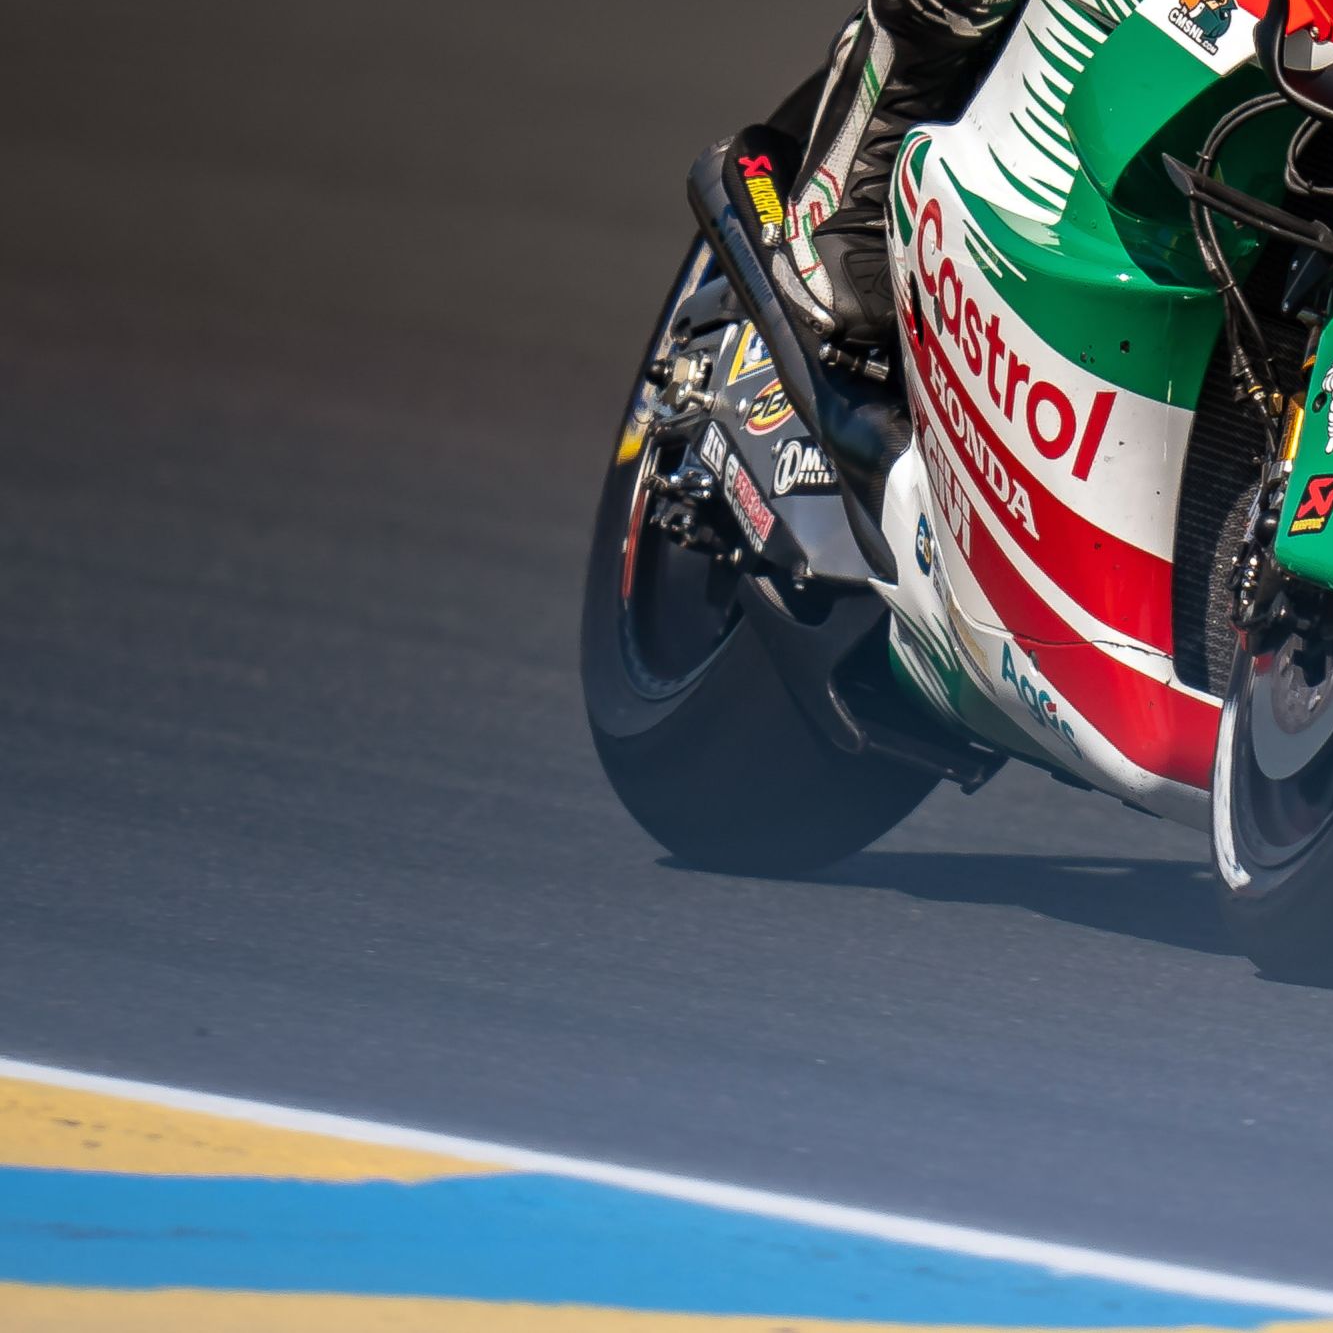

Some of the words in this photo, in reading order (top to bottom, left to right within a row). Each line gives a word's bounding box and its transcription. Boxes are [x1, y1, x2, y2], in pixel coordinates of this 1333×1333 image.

[918, 198, 1118, 482] Castrol
[924, 424, 971, 559] GIVI
[929, 346, 1040, 541] HONDA
